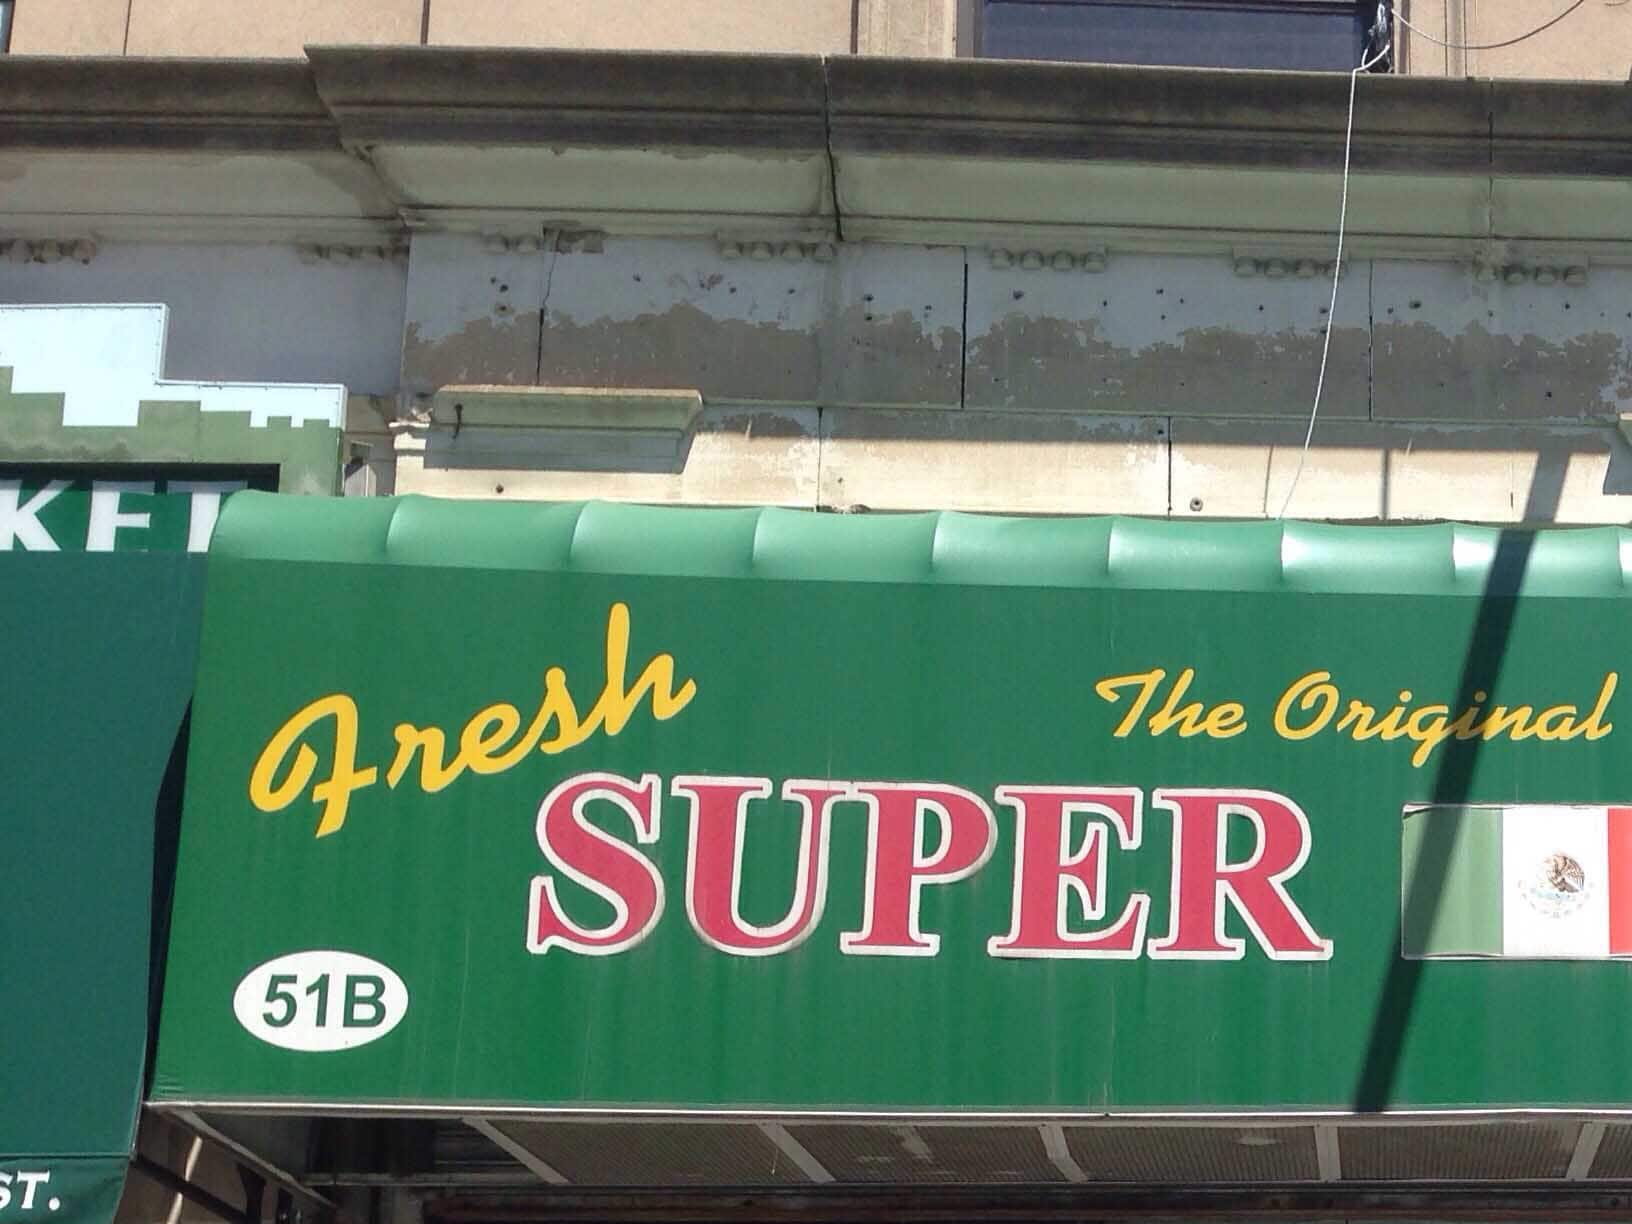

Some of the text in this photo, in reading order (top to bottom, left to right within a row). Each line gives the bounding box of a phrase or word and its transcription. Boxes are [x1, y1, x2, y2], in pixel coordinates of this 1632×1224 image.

[249, 602, 697, 839] Fresh
[1094, 667, 1619, 768] The Original
[526, 773, 1335, 962] SUPER
[261, 973, 388, 1030] 51B
